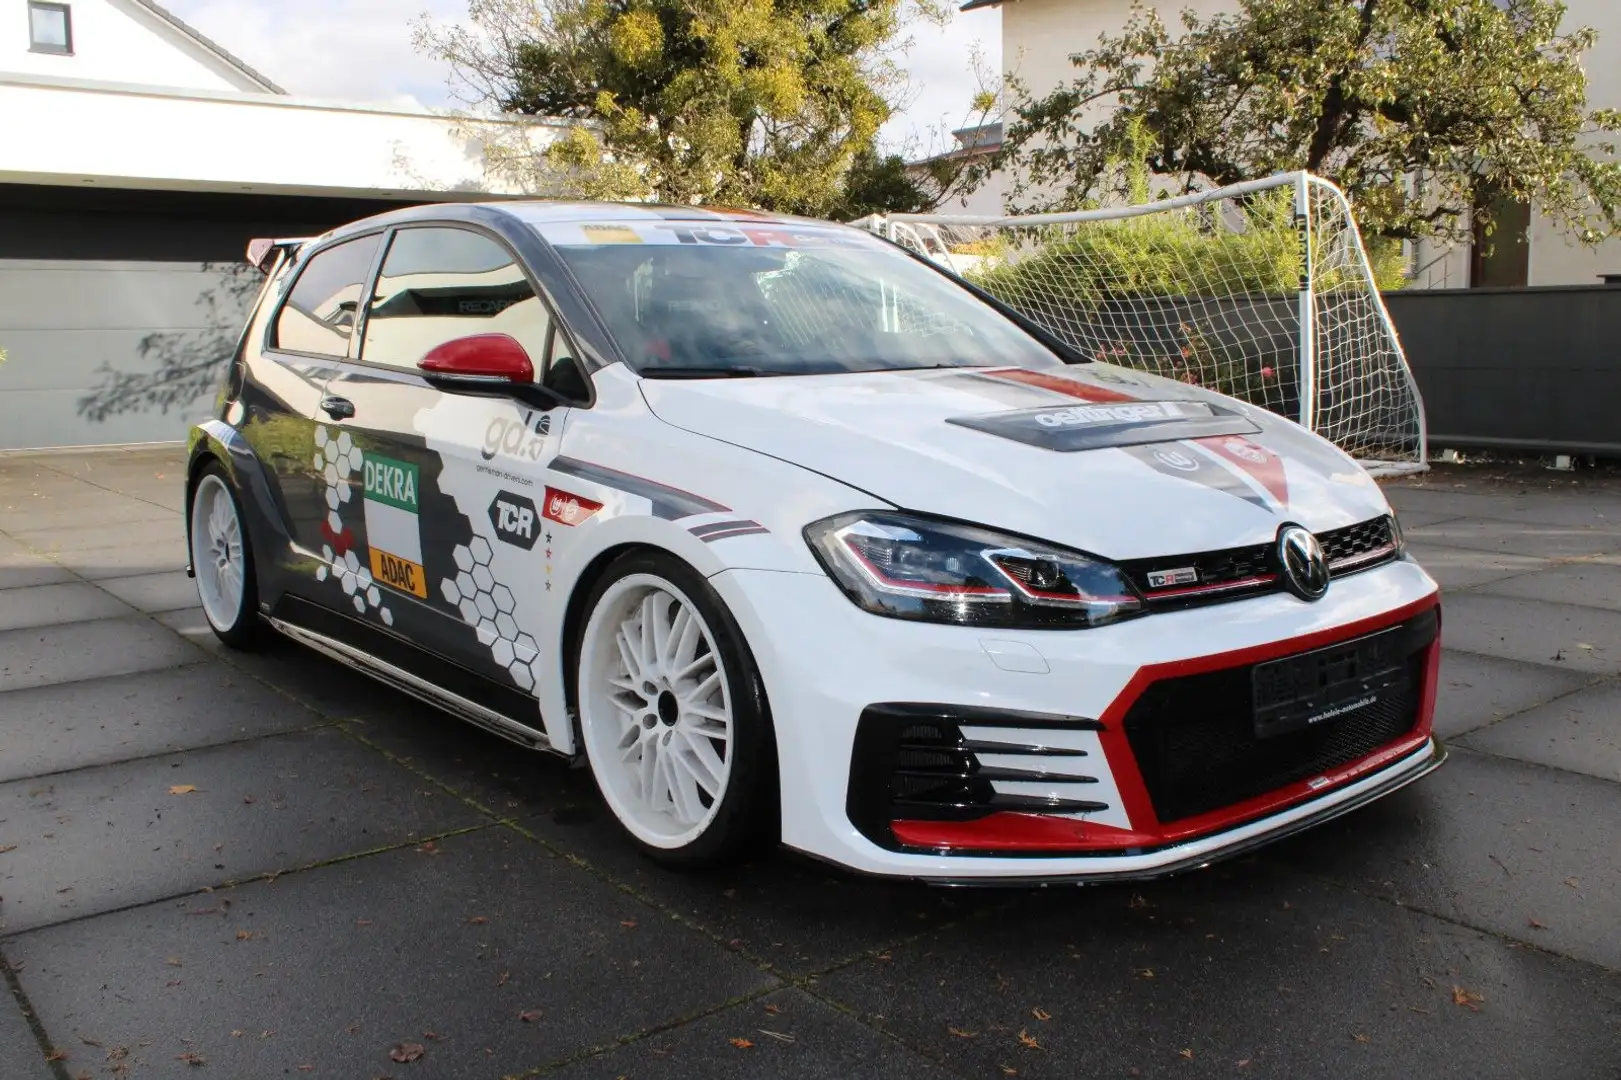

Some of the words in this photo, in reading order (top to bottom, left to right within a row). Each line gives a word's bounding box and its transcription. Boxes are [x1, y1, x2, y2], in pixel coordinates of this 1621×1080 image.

[655, 225, 798, 246] TCR
[1034, 404, 1164, 428] oettinger
[364, 459, 417, 506] DEKRA
[496, 500, 533, 540] TCR
[380, 553, 416, 593] ADAC
[1150, 574, 1174, 586] TCR
